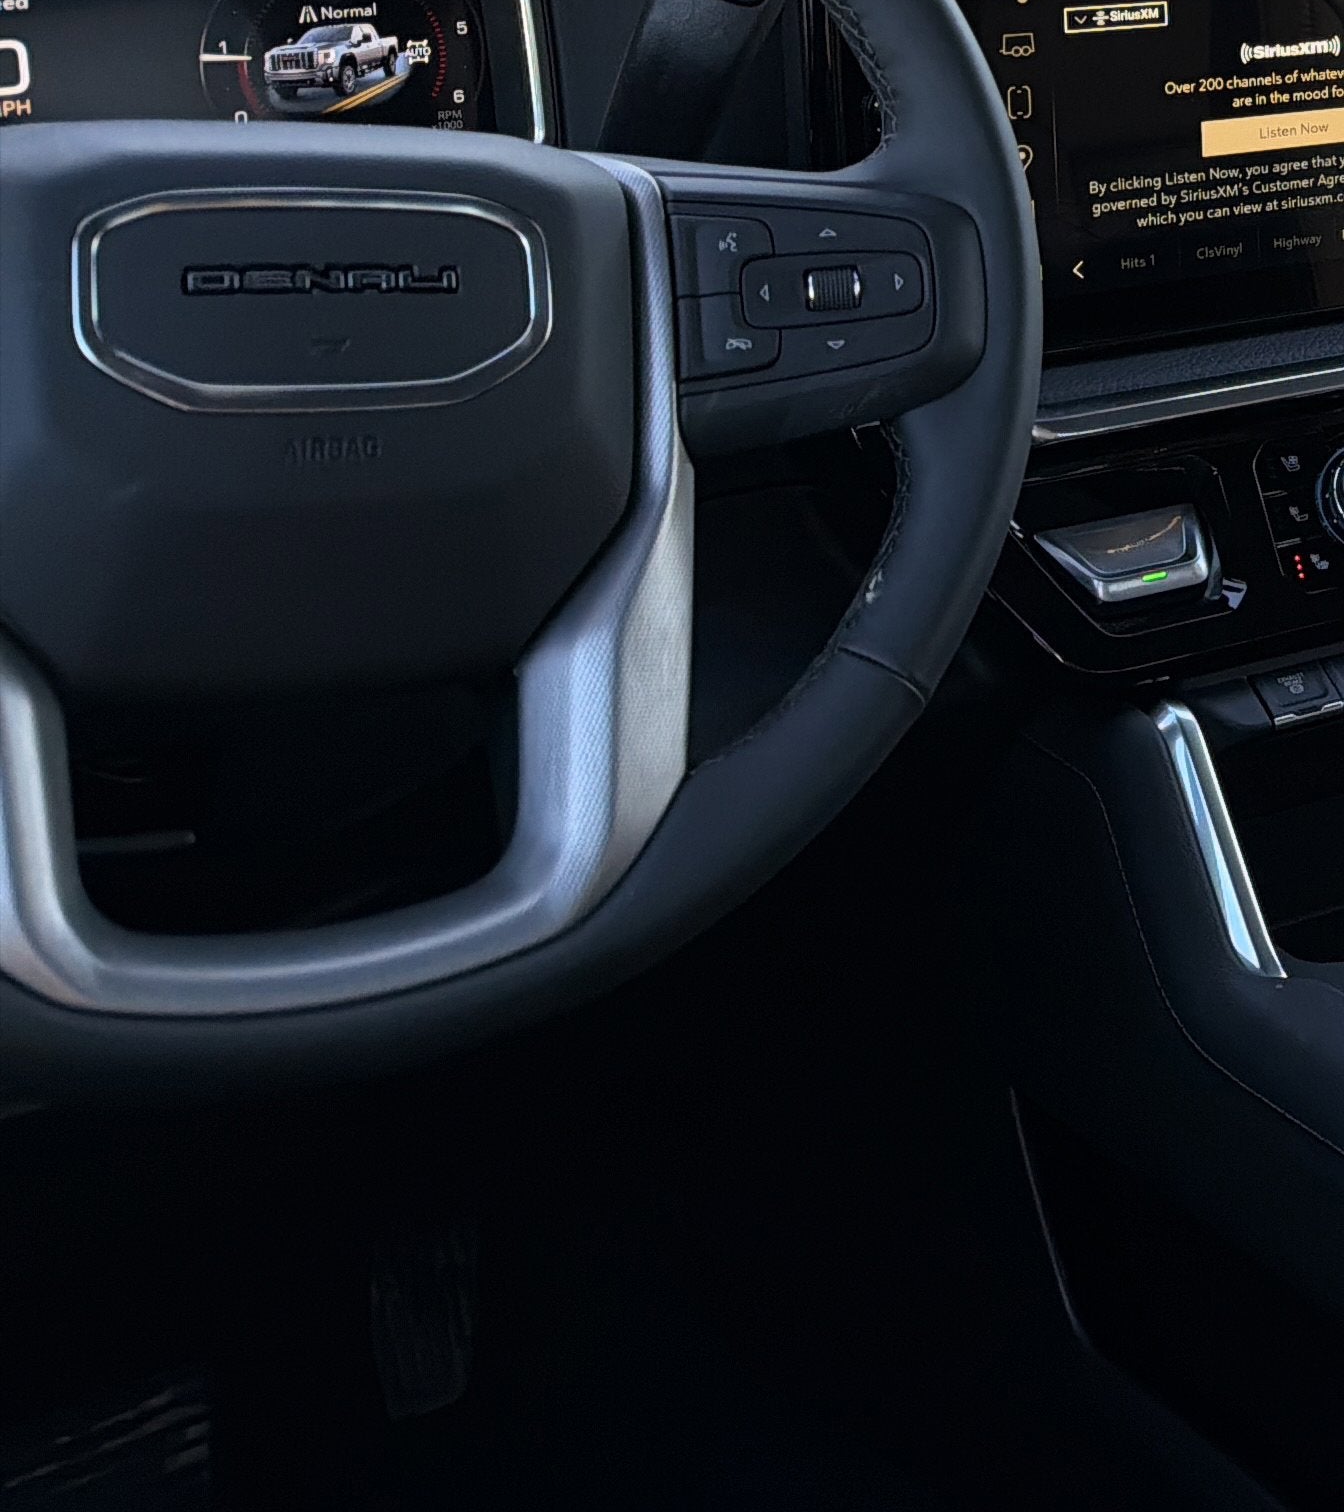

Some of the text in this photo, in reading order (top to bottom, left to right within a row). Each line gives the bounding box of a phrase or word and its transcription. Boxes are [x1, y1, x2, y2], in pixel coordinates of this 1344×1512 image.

[320, 2, 377, 20] Normal
[1109, 8, 1160, 22] SiriusXM
[456, 21, 468, 35] 5
[1164, 81, 1195, 95] Over
[1198, 77, 1224, 92] 200
[1226, 72, 1282, 90] channels
[1285, 71, 1299, 84] of
[453, 88, 466, 103] 6
[1231, 95, 1253, 108] are
[1255, 93, 1267, 106] in
[1269, 91, 1290, 105] the
[1292, 88, 1329, 102] mood
[437, 110, 463, 121] RPM
[1258, 122, 1329, 140] Listen Now
[1088, 180, 1107, 197] By
[1110, 175, 1162, 192] clicking
[1165, 170, 1206, 186] Listen
[1209, 166, 1243, 181] Now,
[1245, 165, 1269, 179] you
[1272, 159, 1309, 176] agree
[1311, 155, 1337, 169] that
[1092, 193, 1158, 218] governed
[1161, 191, 1178, 208] by
[1180, 182, 1250, 203] SiriusXM's
[1252, 176, 1315, 195] Customer
[1136, 210, 1177, 228] which
[1179, 210, 1204, 226] you
[1206, 206, 1231, 219] can
[1233, 201, 1263, 216] view
[1265, 199, 1279, 211] at
[1273, 234, 1322, 250] Highway
[1120, 254, 1156, 270] Hits 1
[181, 264, 460, 296] DENALI
[285, 433, 381, 461] AIRBAG
